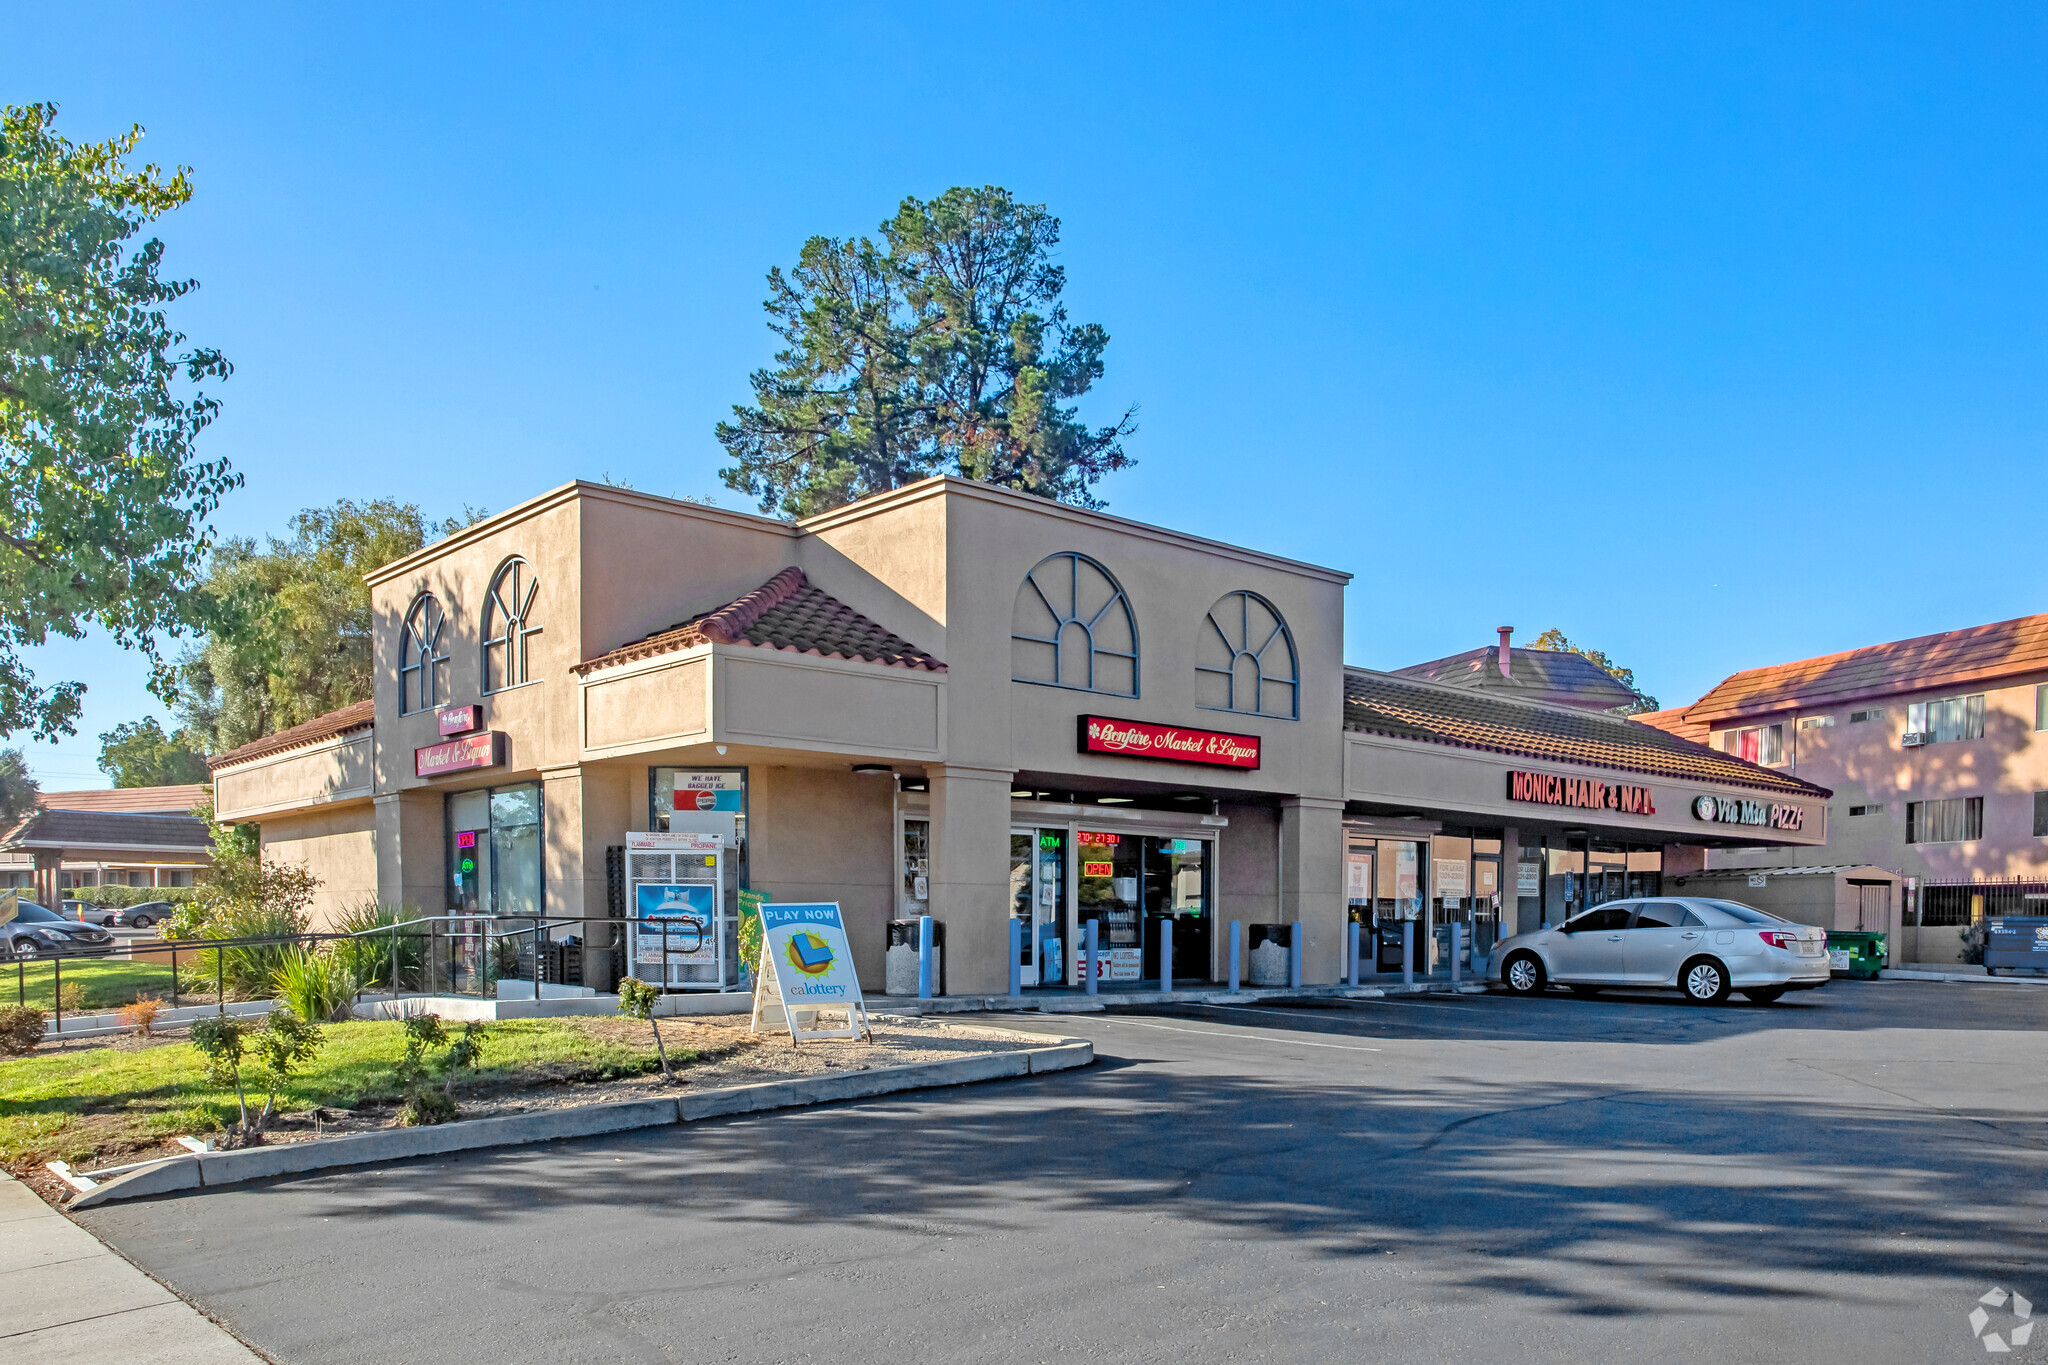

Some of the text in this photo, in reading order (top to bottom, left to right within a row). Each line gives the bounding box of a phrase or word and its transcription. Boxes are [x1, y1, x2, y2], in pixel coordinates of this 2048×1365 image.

[418, 738, 491, 769] Market & Liquor
[1154, 731, 1257, 761] Market & Liquor
[1512, 770, 1656, 815] MONICA HAIR & NAIL
[1715, 796, 1739, 823] Via
[1740, 799, 1767, 825] Mia
[1039, 836, 1061, 848] ATM
[1086, 863, 1111, 876] OPEN
[765, 910, 834, 921] PLAY NOW
[790, 982, 846, 997] calottery
